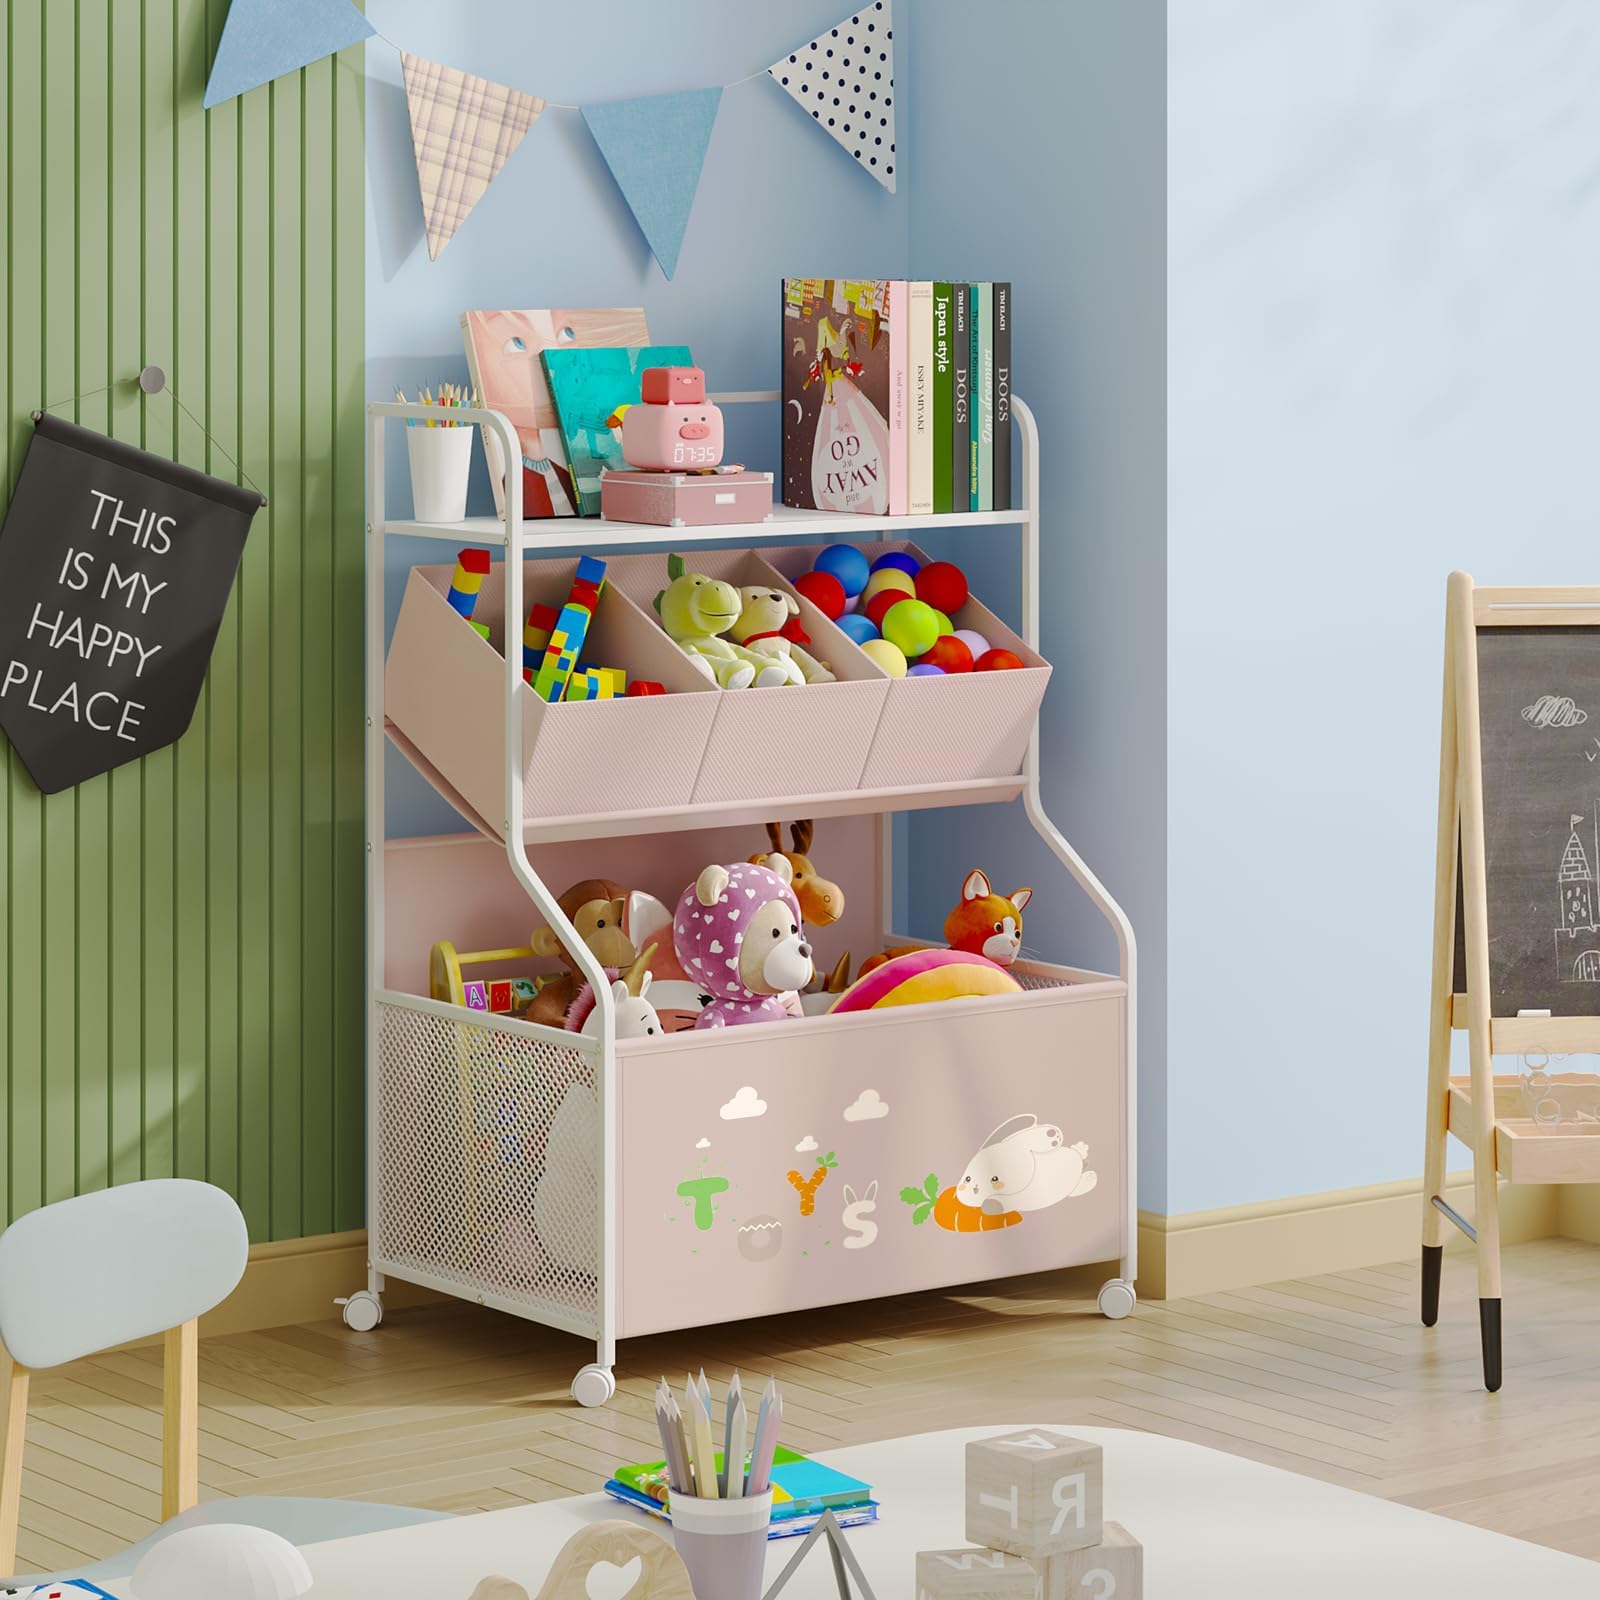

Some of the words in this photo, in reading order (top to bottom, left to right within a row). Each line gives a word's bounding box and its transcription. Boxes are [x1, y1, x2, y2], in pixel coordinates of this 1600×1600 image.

[935, 296, 949, 337] Japan
[935, 341, 949, 373] style
[980, 348, 992, 409] dreamers
[956, 369, 967, 424] DOGS
[998, 367, 1008, 422] DOGS
[673, 446, 715, 463] 07:35
[831, 435, 860, 461] GO
[823, 459, 878, 494] AWAY
[90, 489, 177, 555] THIS
[846, 493, 860, 506] and
[58, 547, 95, 591] IS
[100, 562, 168, 614] MY
[26, 602, 162, 678] HAPPY
[0, 660, 146, 742] PLACE
[469, 985, 484, 1008] A
[979, 1484, 1018, 1529] T
